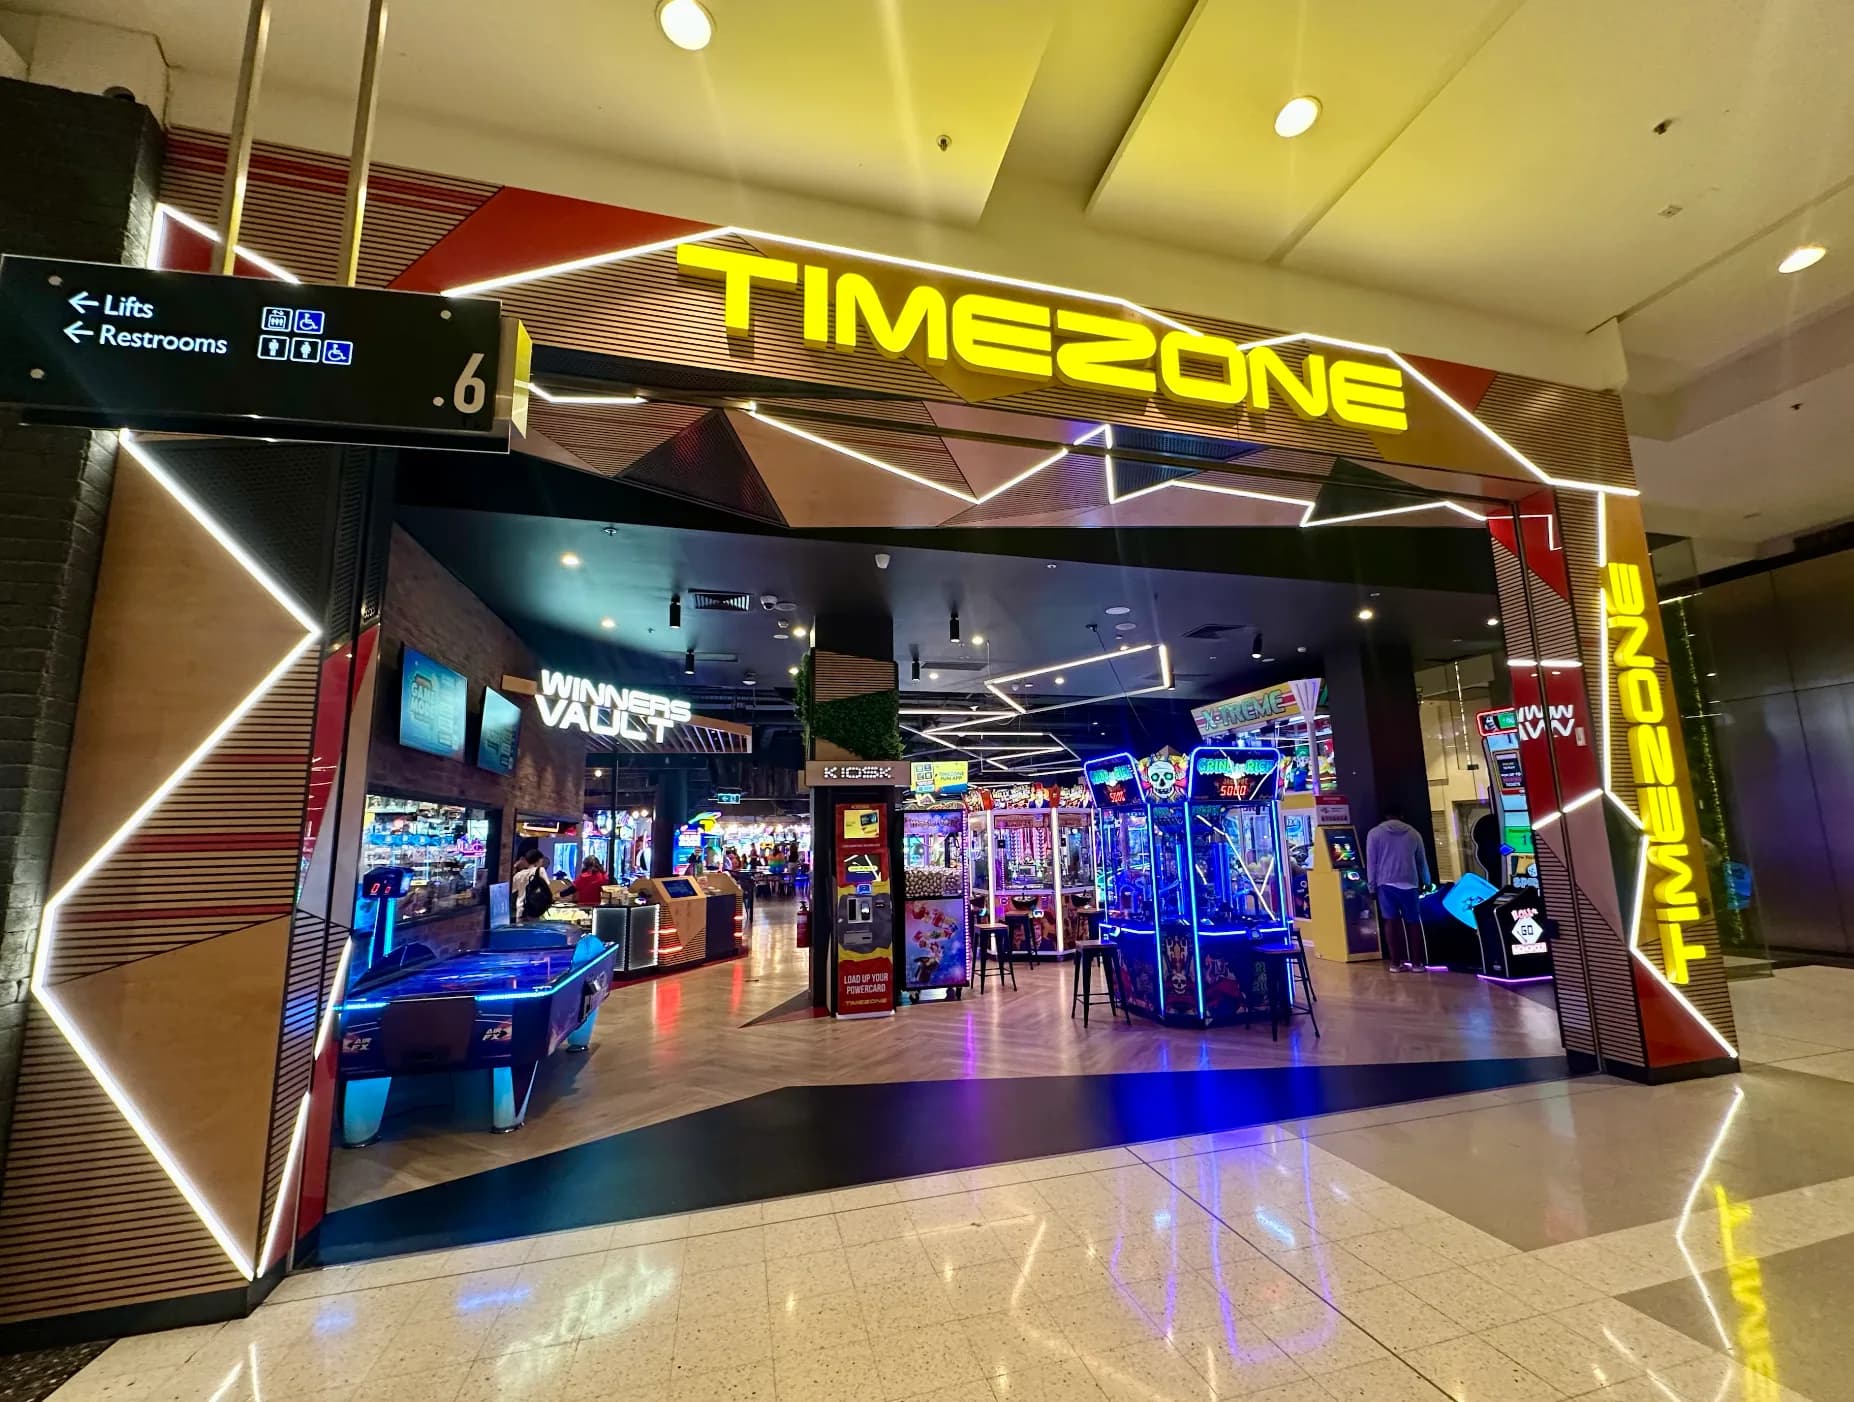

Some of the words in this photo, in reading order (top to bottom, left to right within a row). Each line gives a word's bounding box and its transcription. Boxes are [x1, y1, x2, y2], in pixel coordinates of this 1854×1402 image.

[104, 295, 153, 319] Lifts
[99, 325, 228, 355] Restrooms
[677, 245, 1407, 430] TIMEZONE
[453, 353, 485, 414] 6
[541, 669, 692, 722] WINNERS
[1201, 689, 1286, 730] X-TREME
[535, 694, 674, 743] VAULT
[824, 766, 892, 779] KIOSK
[1607, 562, 1706, 984] TIMEZONE
[1219, 785, 1247, 796] 5000
[844, 975, 861, 985] LOAD
[862, 974, 871, 983] UP
[872, 972, 889, 982] YOUR
[846, 984, 887, 995] POWERCARD
